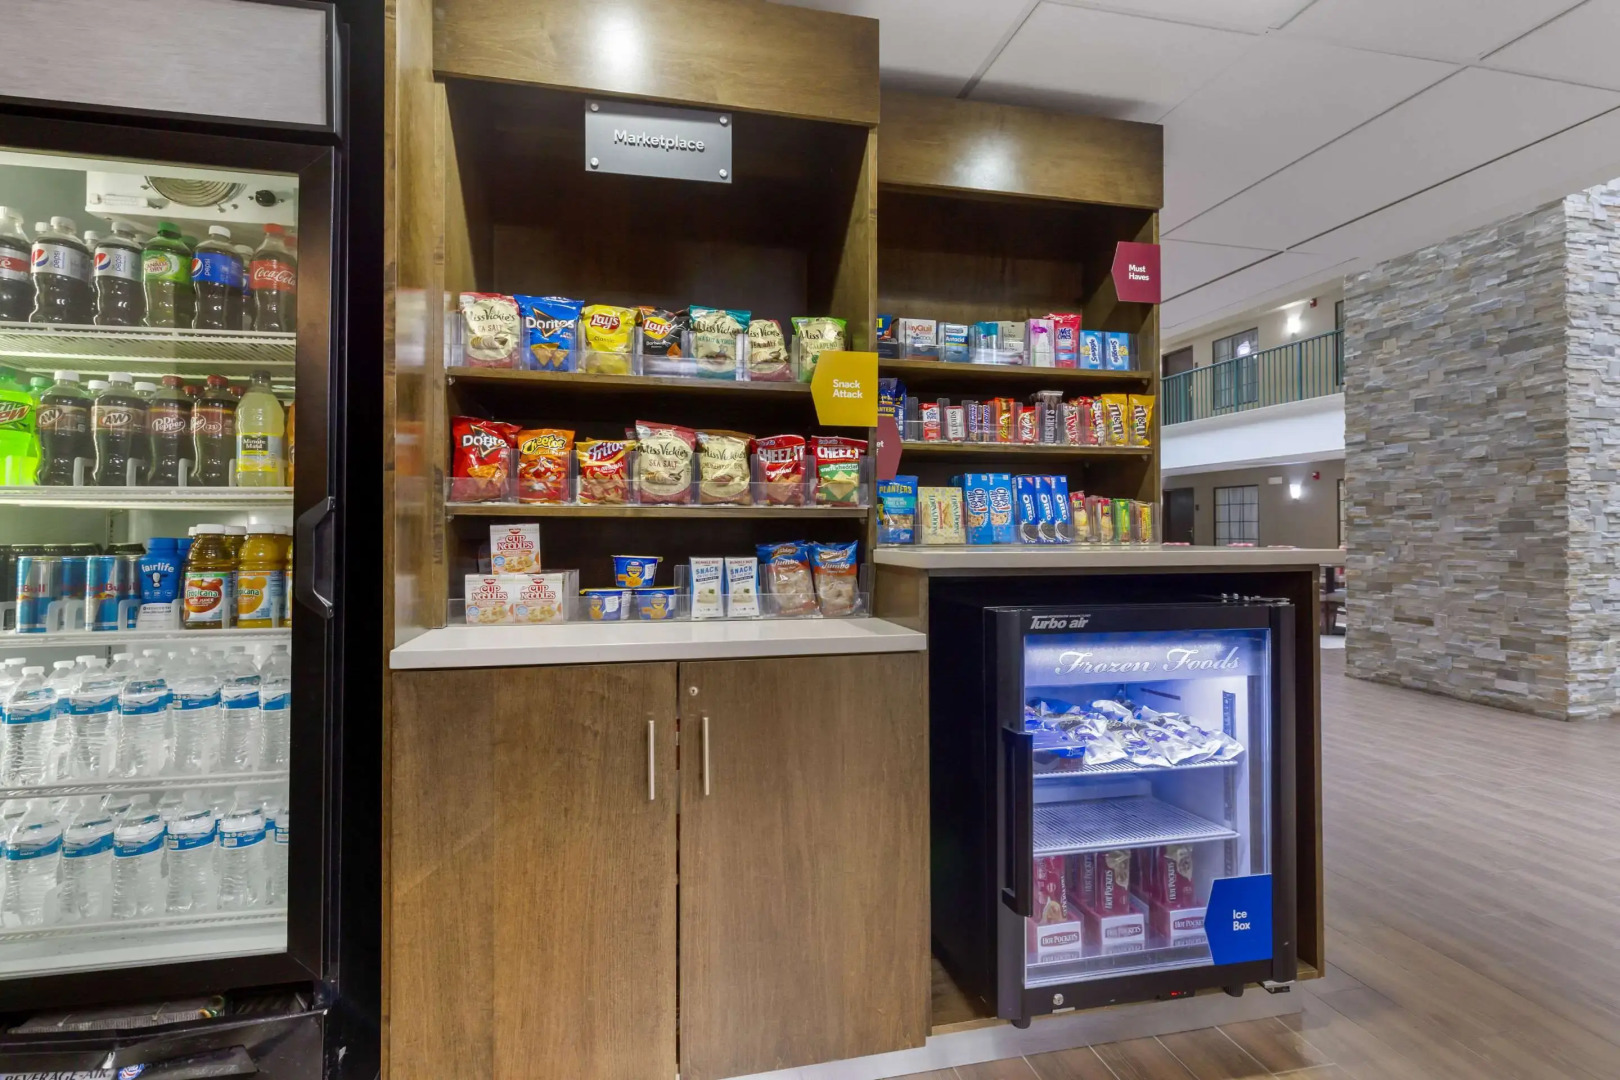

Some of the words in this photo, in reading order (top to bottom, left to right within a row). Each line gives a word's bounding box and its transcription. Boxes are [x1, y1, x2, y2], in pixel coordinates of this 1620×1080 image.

[614, 129, 706, 152] Marketplace
[1128, 264, 1146, 273] Must
[1128, 272, 1150, 281] Haves
[525, 316, 575, 330] Doritos
[591, 314, 620, 329] Lay's
[643, 320, 671, 335] Lay's
[833, 379, 861, 390] Snack
[833, 388, 863, 399] Attack
[154, 419, 184, 432] Pepper
[950, 411, 959, 435] ALTOIDS
[522, 434, 566, 455] Cheetos
[588, 441, 627, 461] Fritos
[878, 483, 913, 494] PLANTERS
[1023, 495, 1034, 521] OREO
[1041, 494, 1052, 521] OREO
[1057, 494, 1067, 521] OREO
[505, 534, 527, 543] CUP
[497, 541, 534, 551] NOODLES
[142, 562, 175, 573] fairlife
[773, 558, 799, 567] Jumbo
[821, 562, 851, 570] Jumbo
[695, 566, 719, 575] SNACK
[730, 565, 753, 575] SNACK
[24, 584, 45, 592] Bull
[186, 589, 218, 598] Tropicana
[480, 585, 501, 594] CUP
[528, 585, 549, 594] CUP
[471, 592, 508, 601] NOODLES
[520, 591, 556, 600] NOODLES
[1030, 615, 1067, 630] Turbo
[1068, 618, 1088, 629] air
[1055, 650, 1155, 675] Frozen
[1162, 646, 1240, 672] Foods
[1104, 869, 1114, 895] POCKETS
[1232, 910, 1248, 920] Ice
[1232, 920, 1251, 931] Box
[1042, 936, 1053, 945] HOT
[1054, 933, 1078, 943] POCKETS
